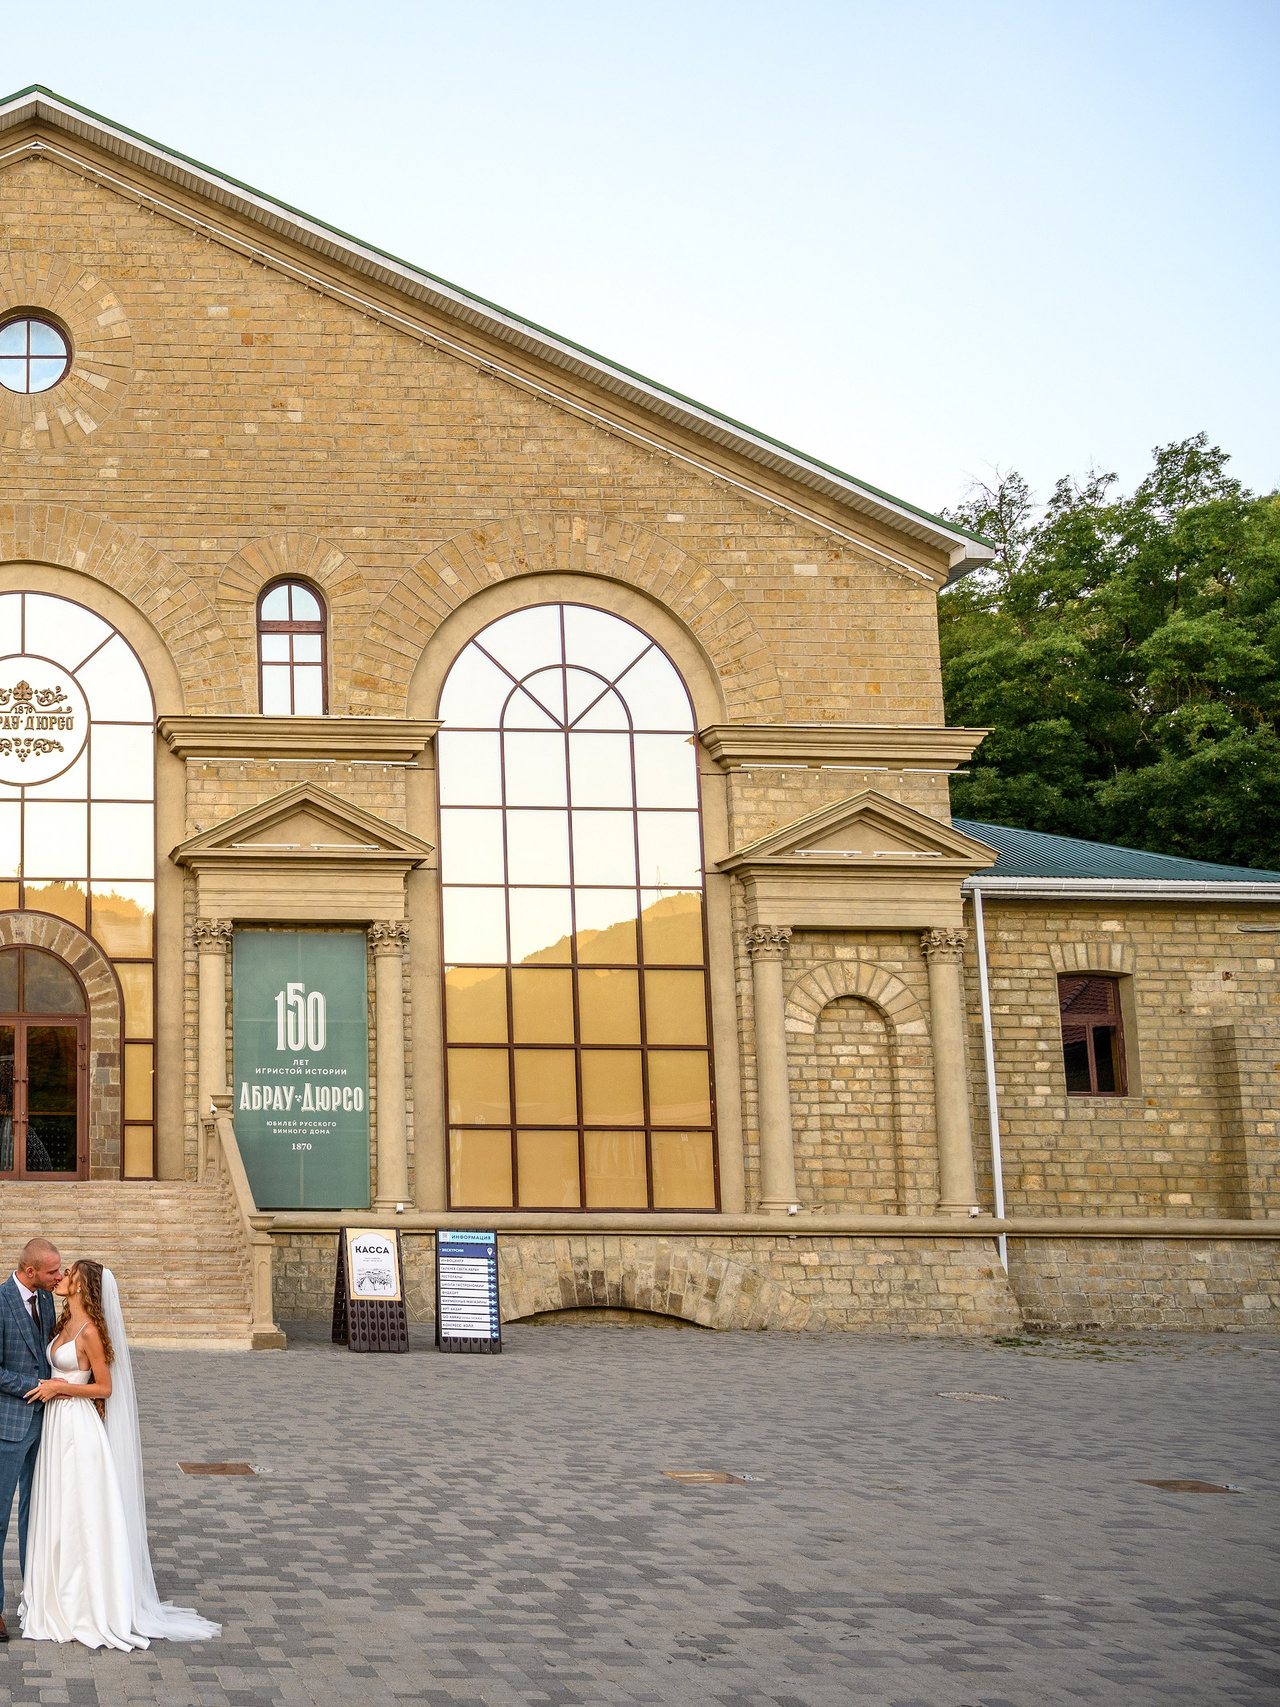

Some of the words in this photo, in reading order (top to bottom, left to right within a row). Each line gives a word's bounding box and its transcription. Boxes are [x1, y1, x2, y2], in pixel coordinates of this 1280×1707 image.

[14, 706, 33, 715] 1870
[275, 982, 327, 1051] 150
[255, 1067, 302, 1075] ИГРИСТОЙ
[355, 1246, 390, 1254] КАССА
